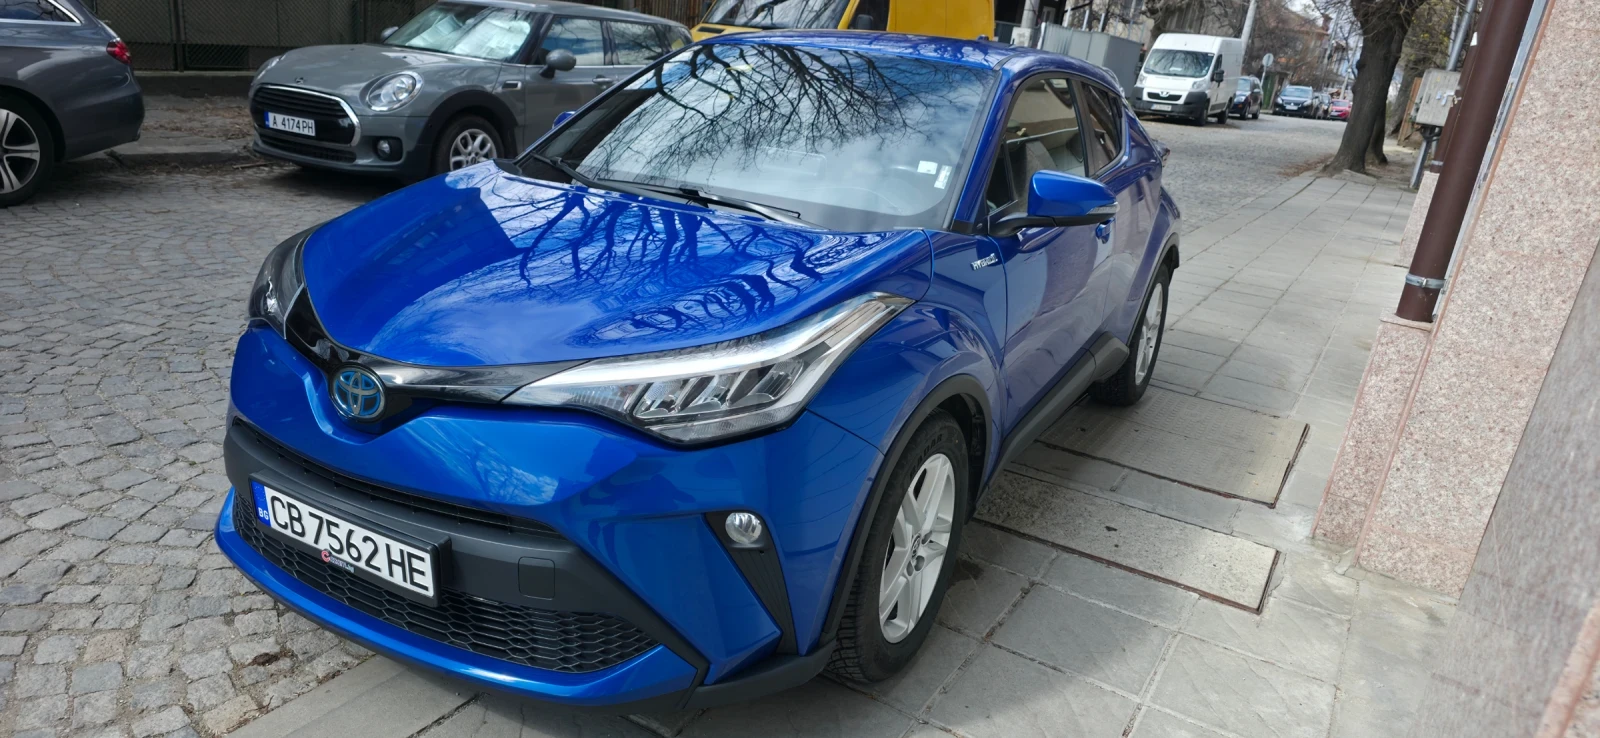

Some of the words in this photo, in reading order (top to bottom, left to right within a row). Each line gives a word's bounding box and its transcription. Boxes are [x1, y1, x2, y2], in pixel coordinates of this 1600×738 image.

[272, 115, 278, 127] A
[281, 117, 301, 131] 4174
[302, 120, 314, 134] PH
[258, 507, 269, 521] BG
[270, 495, 306, 538] CB
[308, 511, 382, 573] 7562
[385, 542, 429, 592] HE
